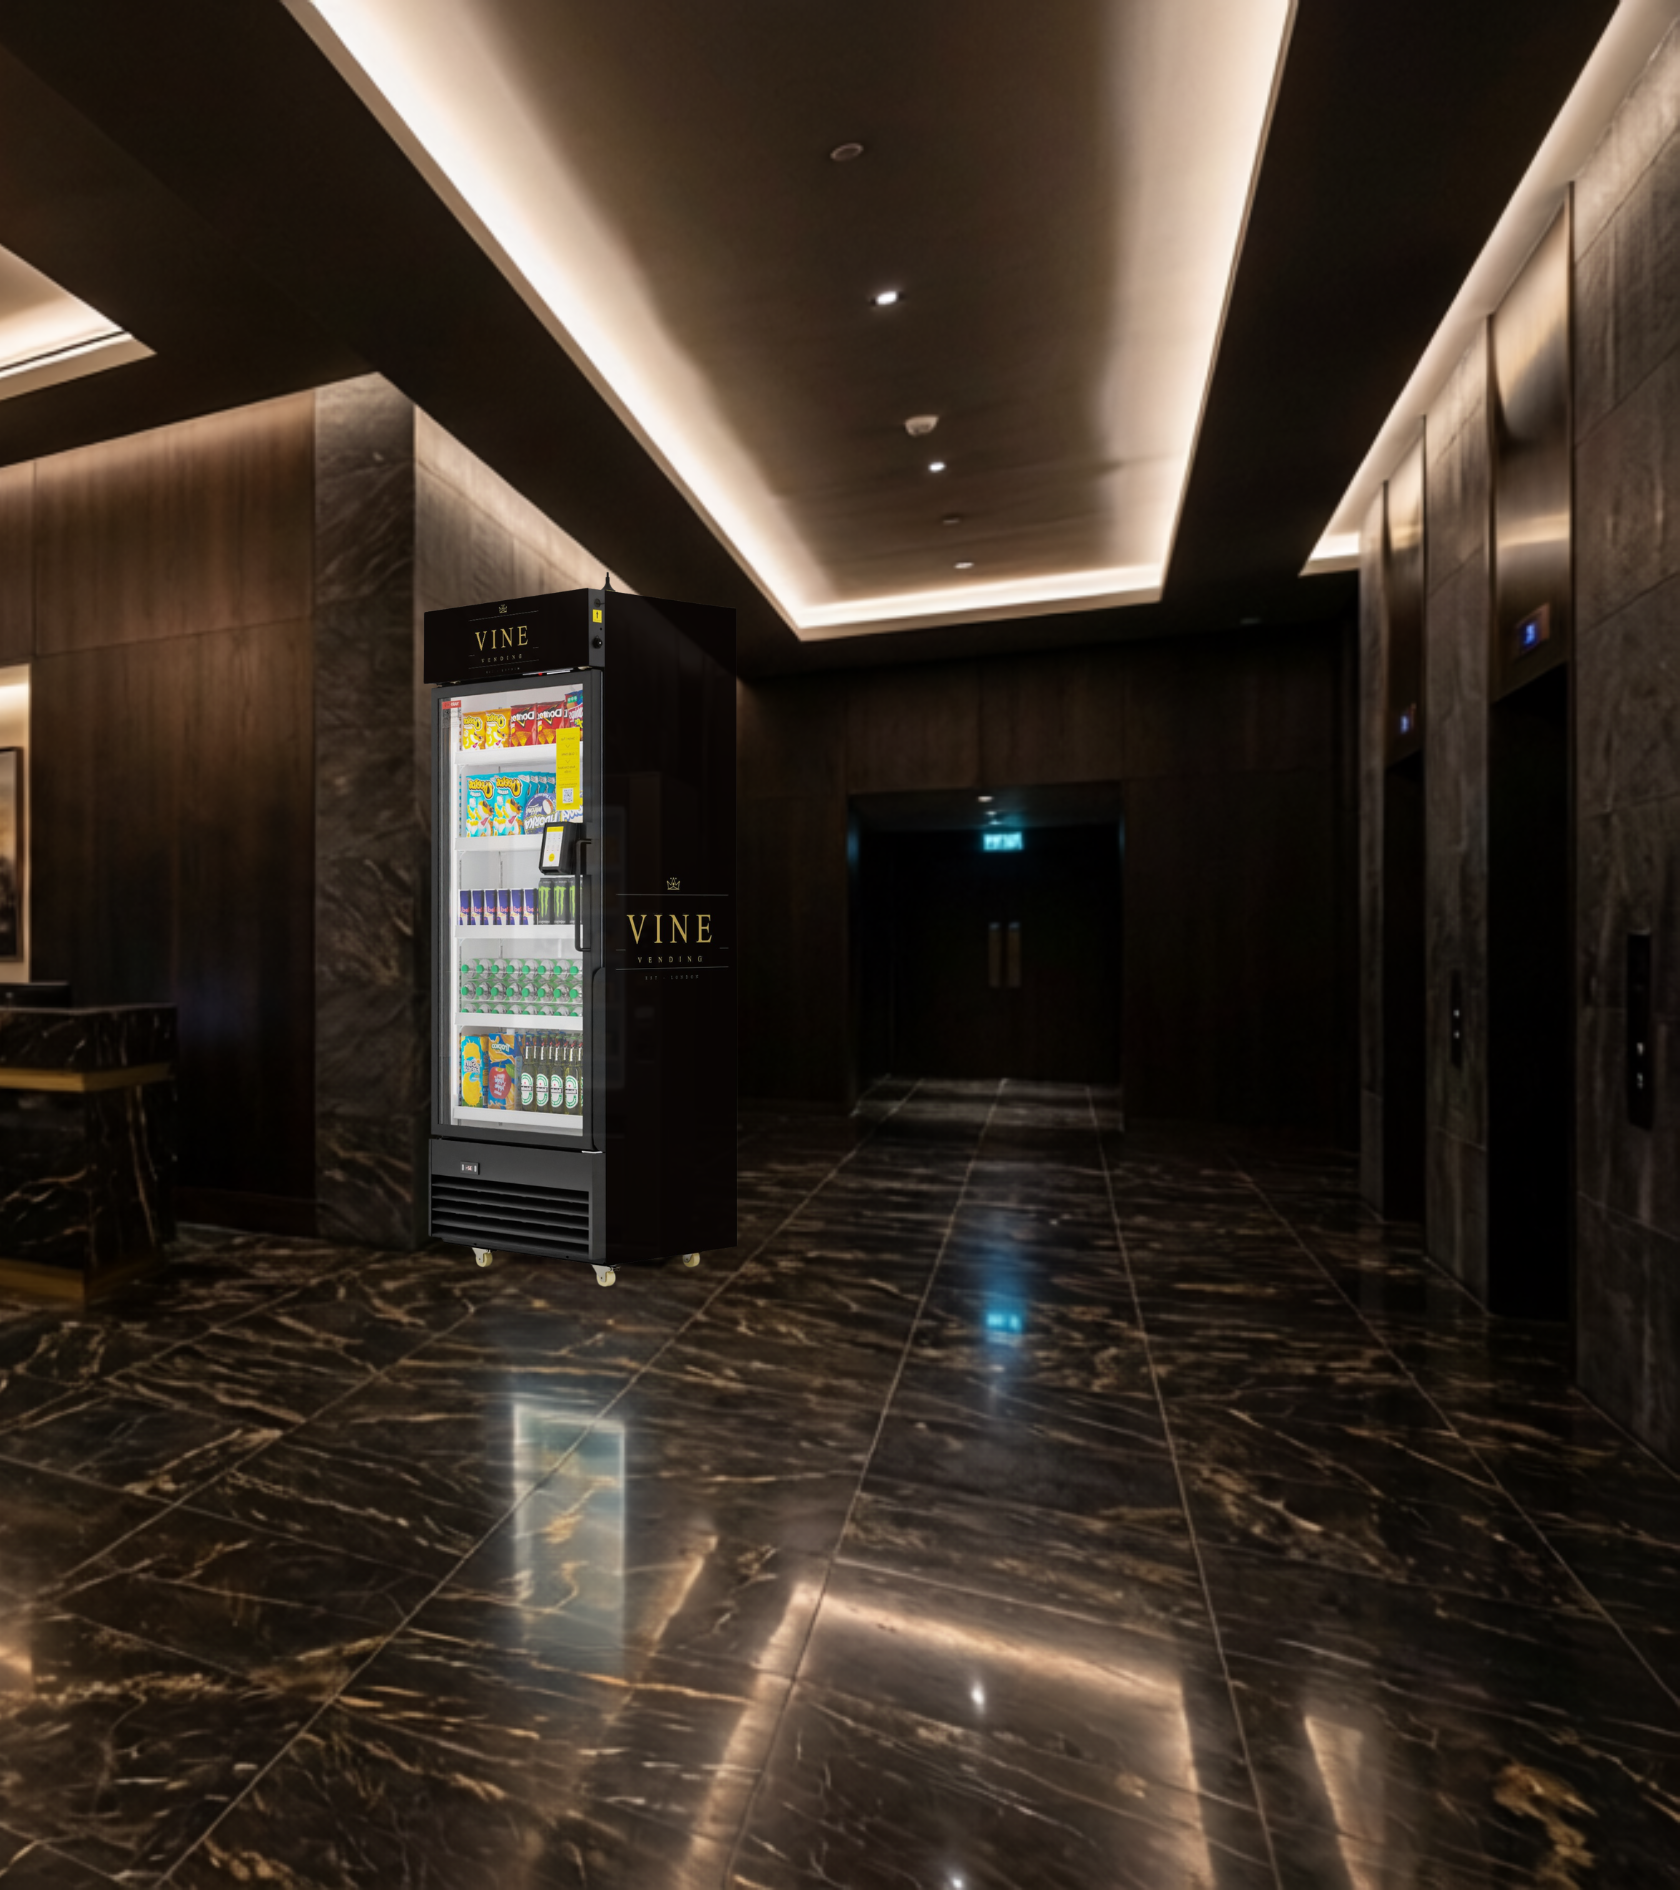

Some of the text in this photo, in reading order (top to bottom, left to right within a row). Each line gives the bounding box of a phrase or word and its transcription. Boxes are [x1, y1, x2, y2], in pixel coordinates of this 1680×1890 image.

[475, 625, 529, 652] VINE
[481, 653, 523, 663] VENDING
[626, 914, 713, 945] VINE
[637, 955, 704, 964] VENDING
